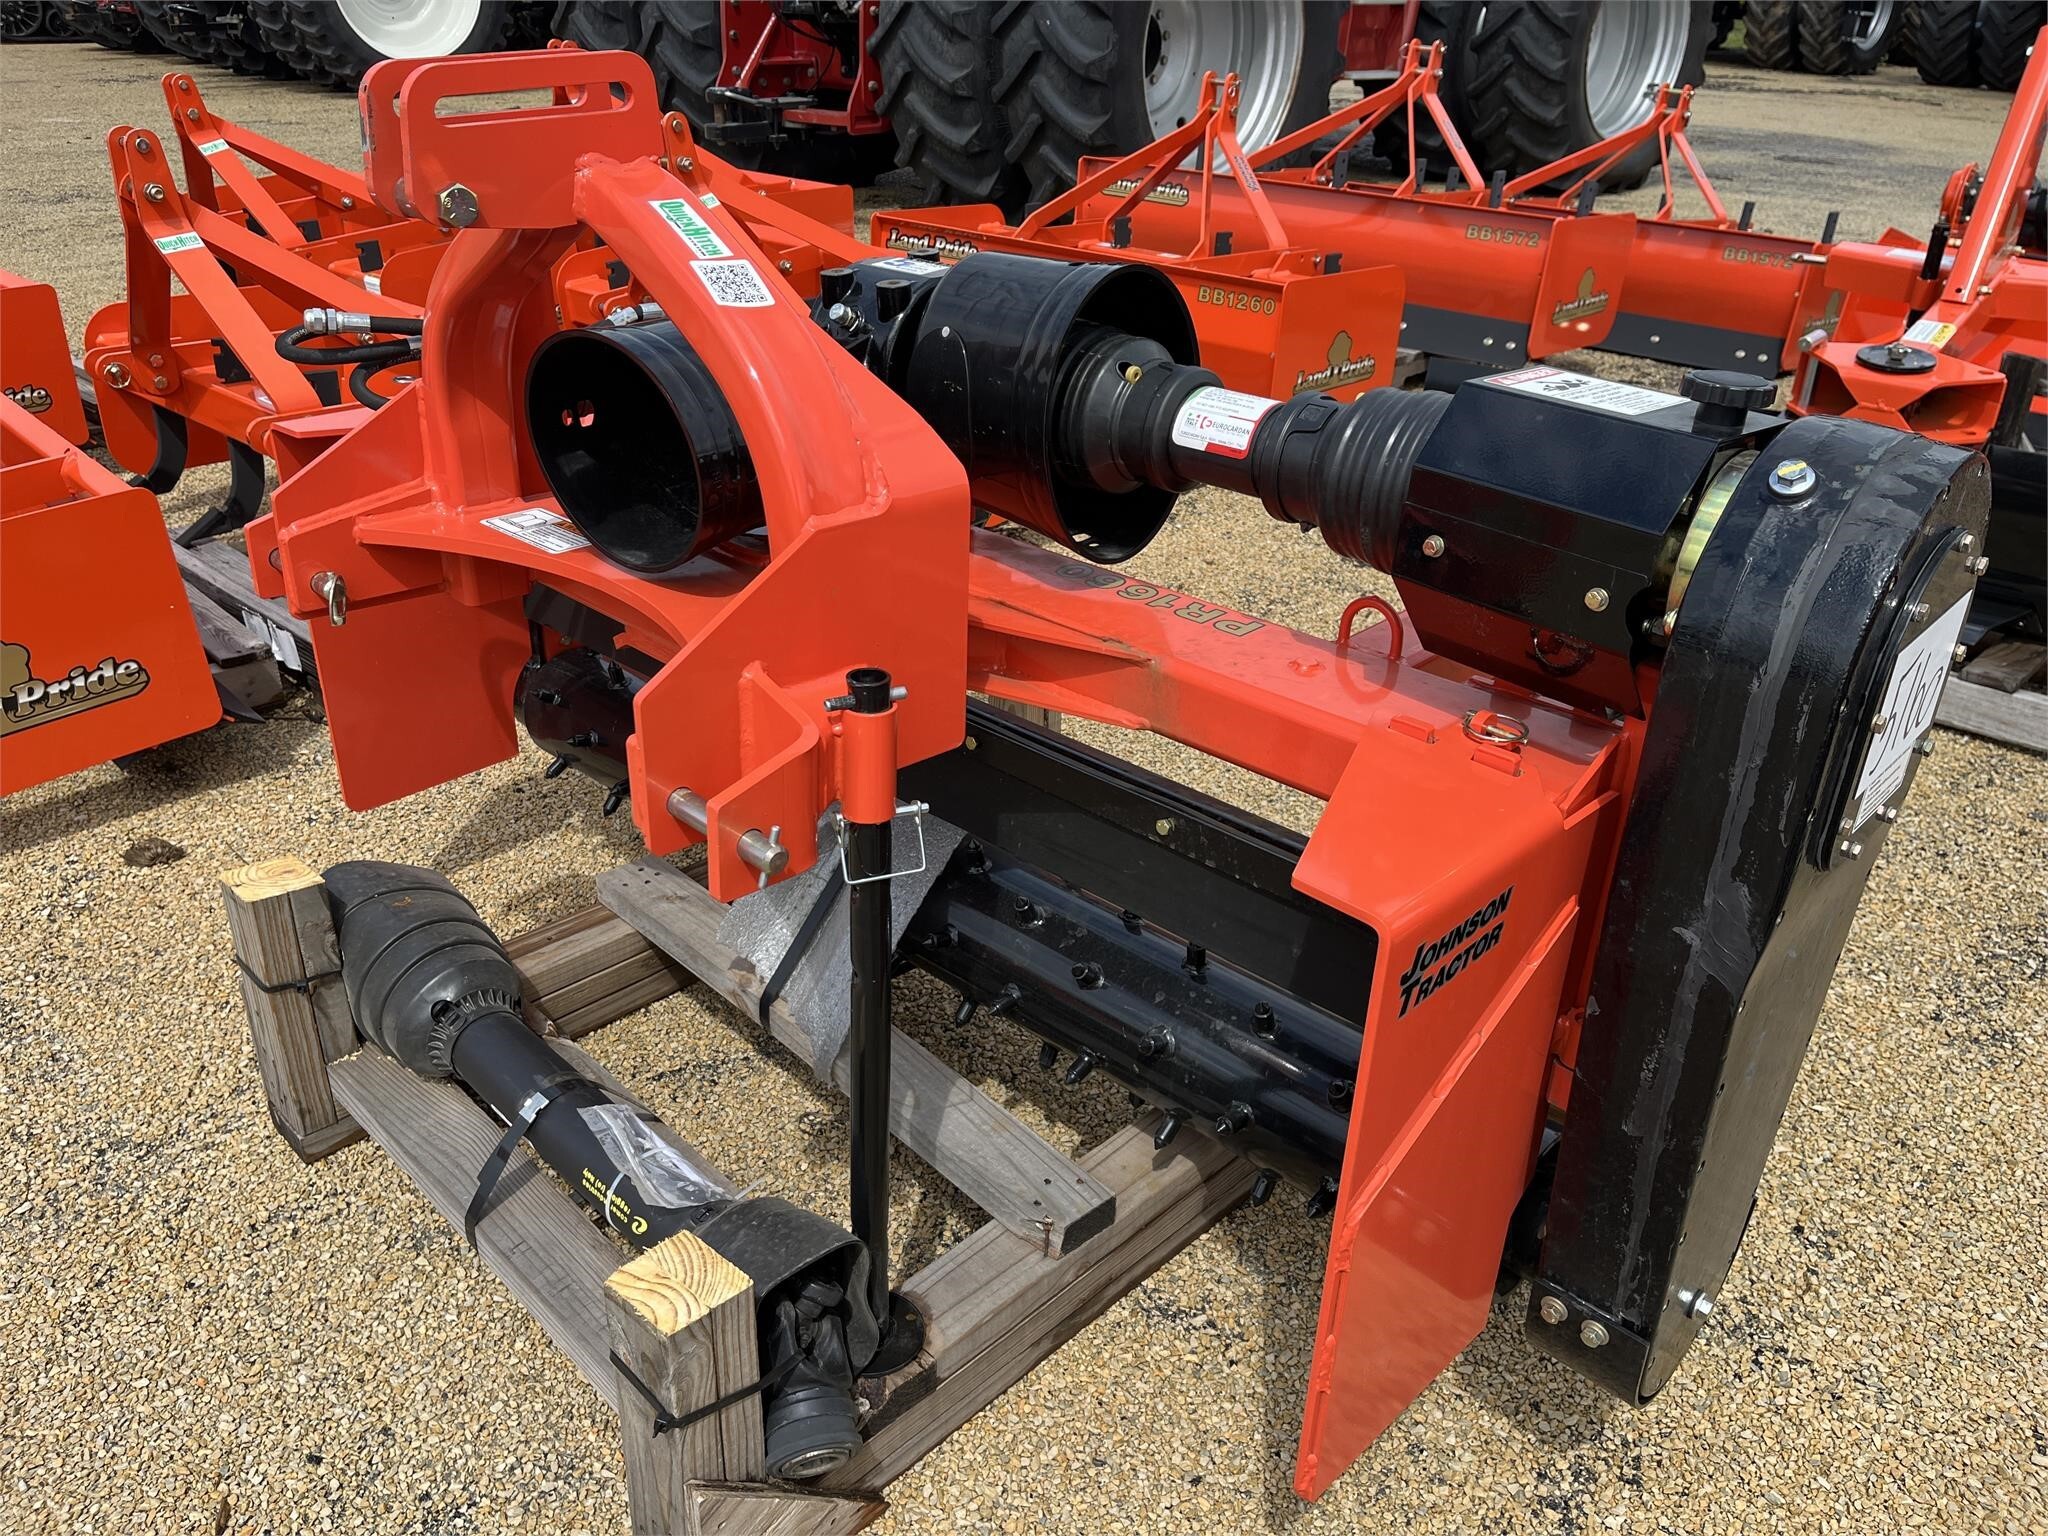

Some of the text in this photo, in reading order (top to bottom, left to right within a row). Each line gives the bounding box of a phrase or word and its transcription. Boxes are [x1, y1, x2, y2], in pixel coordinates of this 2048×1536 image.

[887, 228, 930, 250] Land
[1465, 224, 1541, 247] BB1572
[1723, 246, 1794, 270] BB1572
[1198, 286, 1276, 316] BB1260
[1295, 355, 1375, 391] Land Pride
[4, 384, 50, 407] ide
[1212, 422, 1250, 436] EUROCARDAN
[1056, 563, 1265, 637] PR1660
[10, 656, 141, 719] Pride
[1400, 885, 1515, 986] JOHNSON
[1398, 921, 1505, 1020] TRACTOR
[582, 1178, 608, 1205] ndustries
